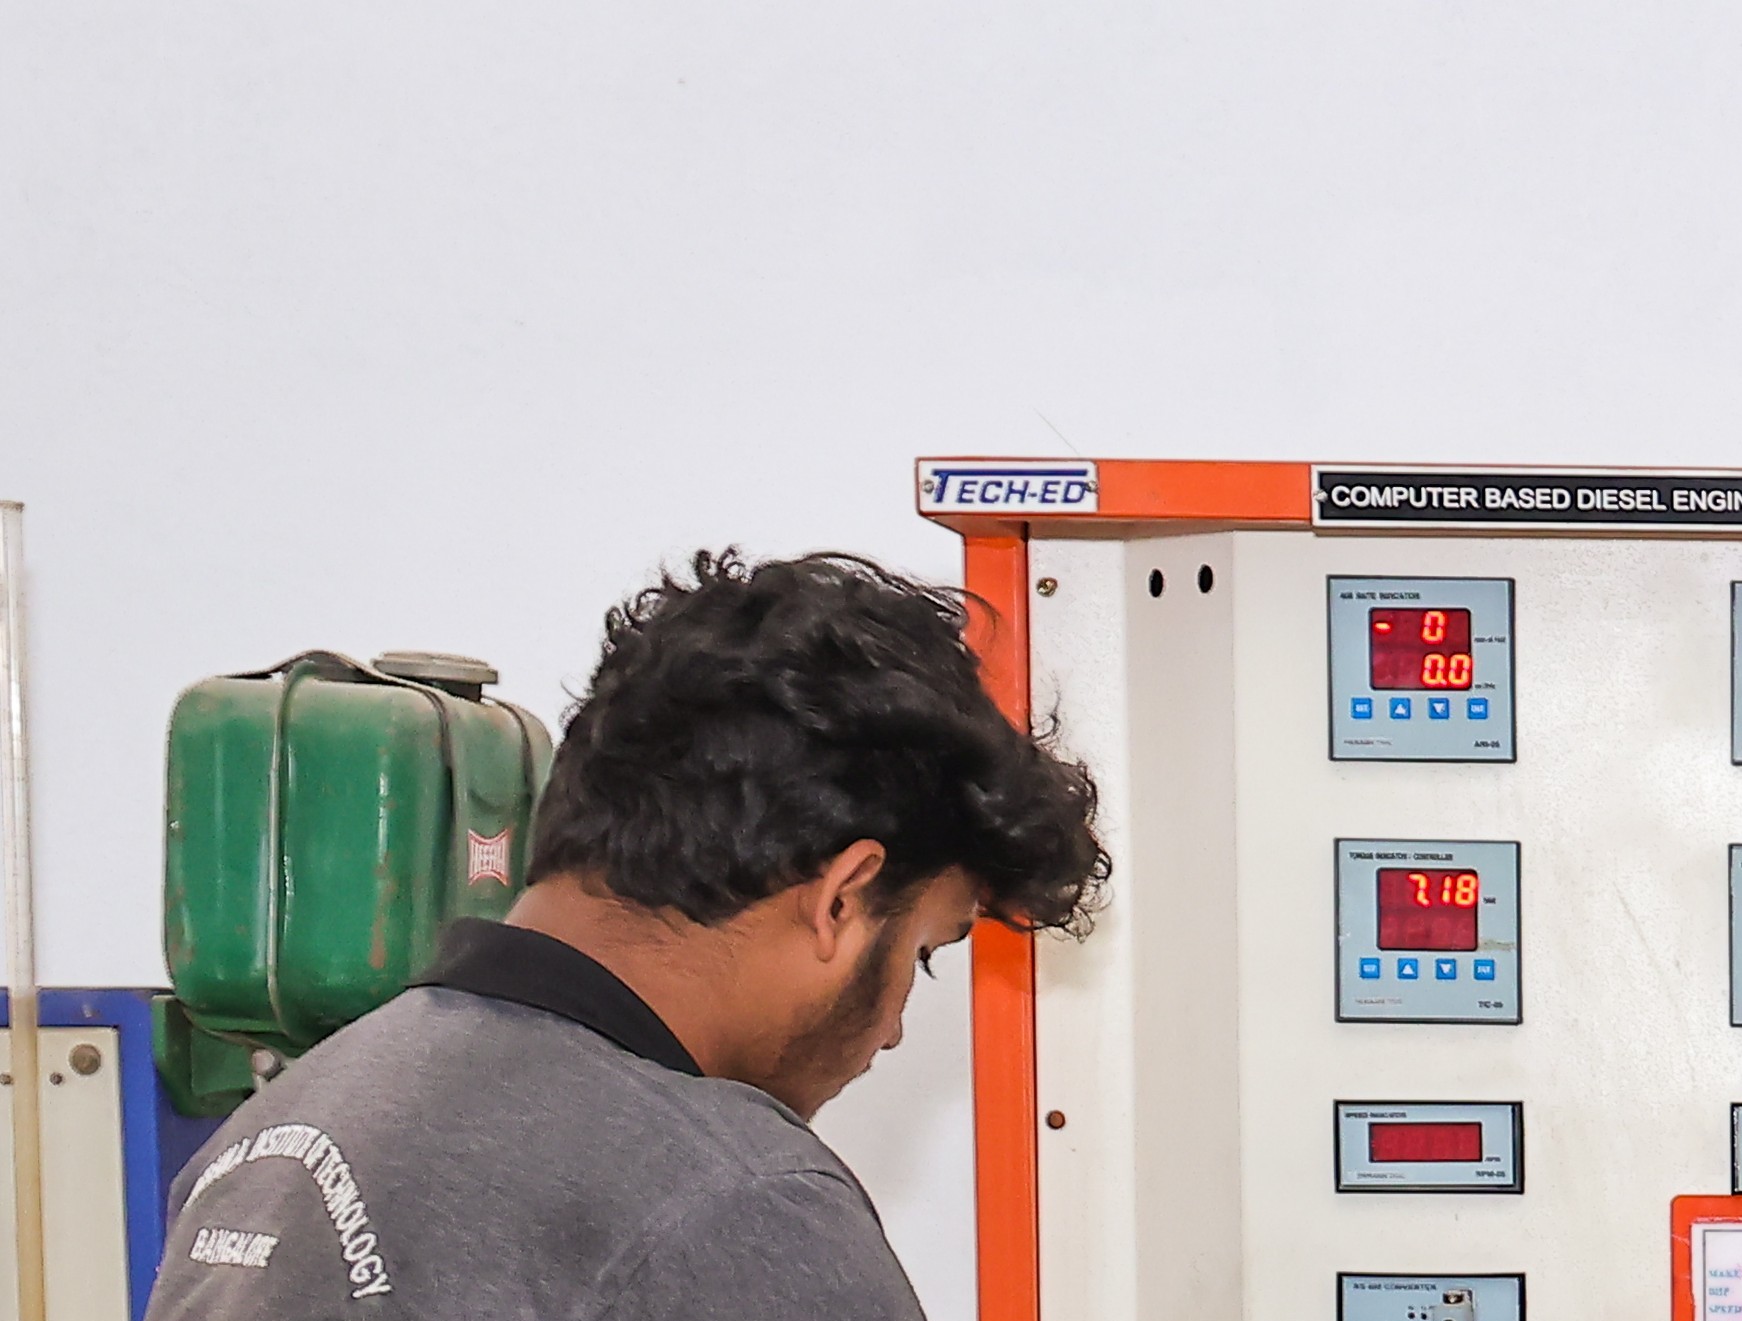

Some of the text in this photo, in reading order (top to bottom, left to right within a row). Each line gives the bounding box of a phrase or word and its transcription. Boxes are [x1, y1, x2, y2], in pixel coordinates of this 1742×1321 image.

[932, 469, 1088, 503] TECH-ED
[1331, 485, 1477, 509] COMPUTER
[1485, 486, 1570, 510] BASED
[1578, 487, 1667, 511] DIESEL
[1422, 611, 1446, 643] 0
[1422, 653, 1472, 686] 0.0
[313, 1144, 393, 1299] TECHNOLOGY
